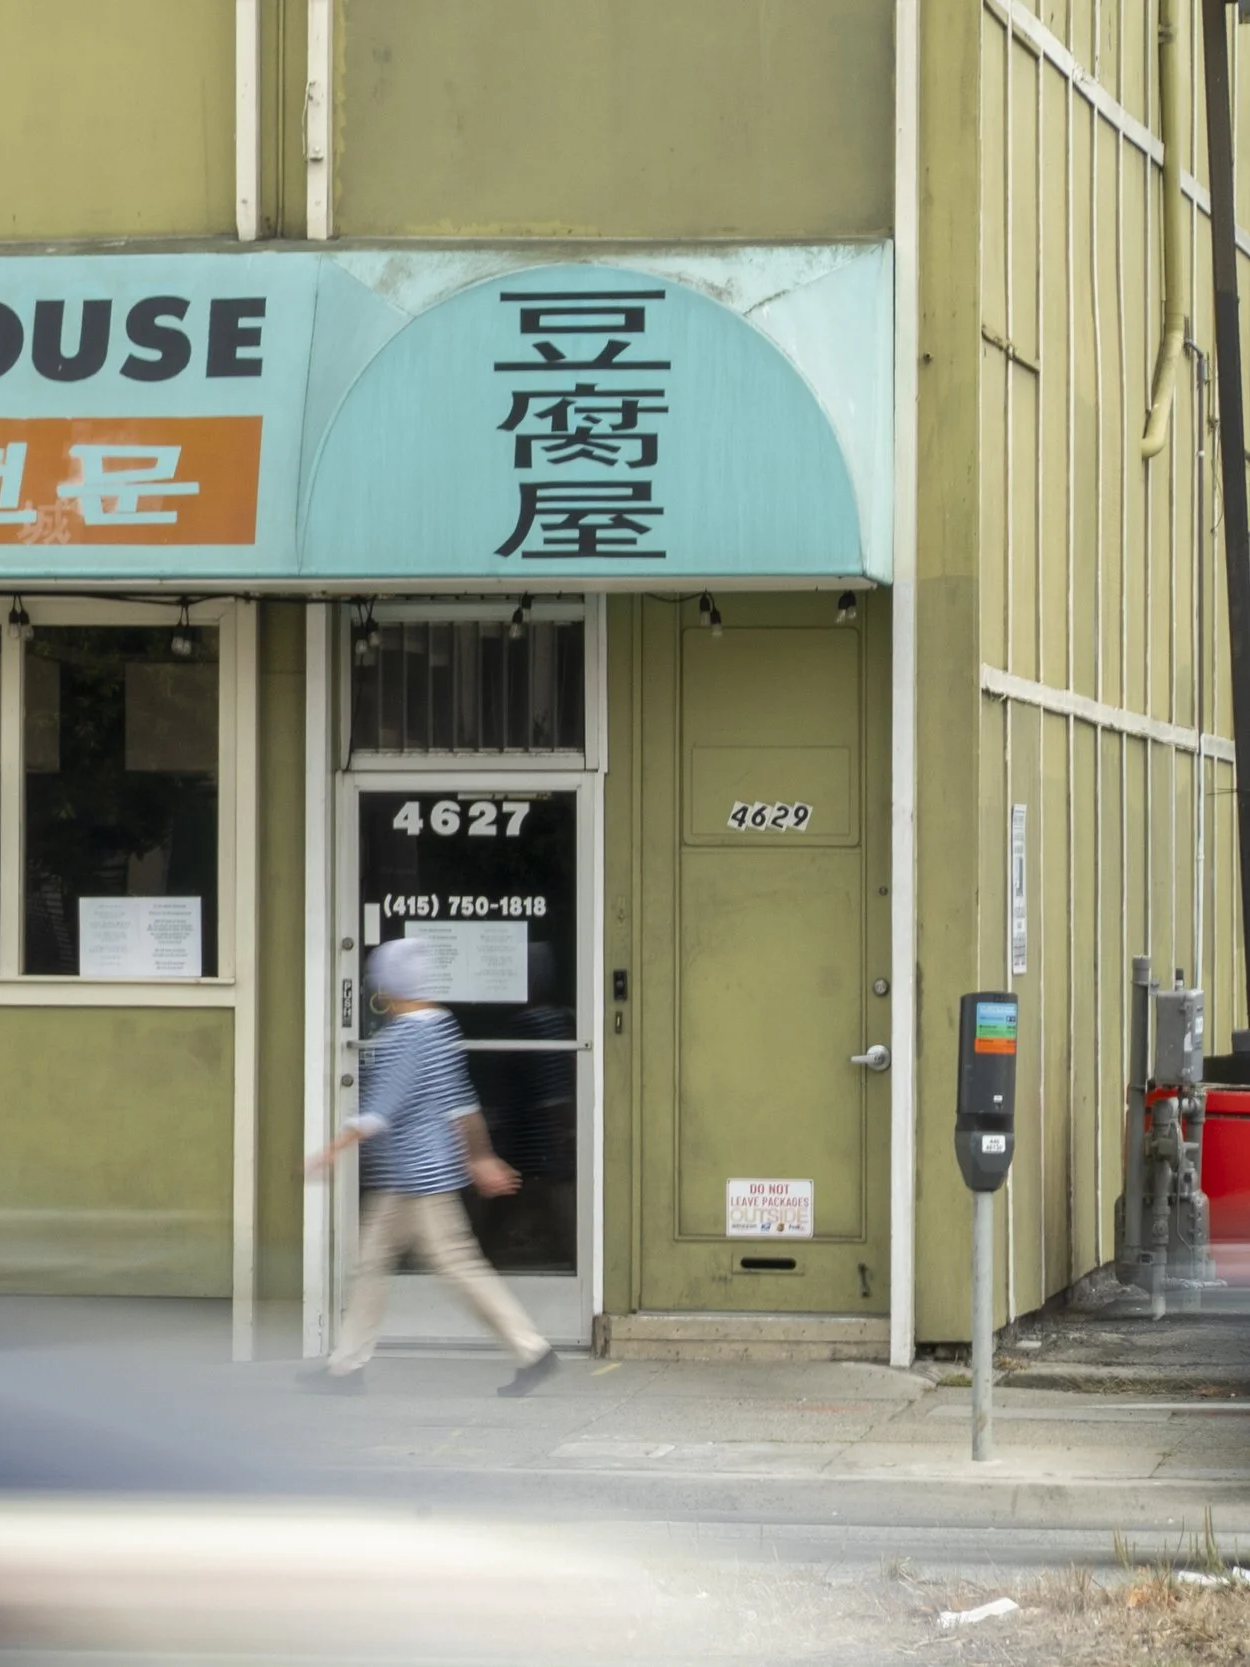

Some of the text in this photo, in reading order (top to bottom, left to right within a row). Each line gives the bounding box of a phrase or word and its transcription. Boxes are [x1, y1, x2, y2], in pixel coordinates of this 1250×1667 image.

[493, 289, 671, 558] 豆腐屋
[392, 800, 531, 837] 4627
[730, 804, 809, 829] 4629
[383, 893, 547, 918] (415) 750-1818
[749, 1183, 790, 1195] DO NOT
[730, 1196, 810, 1208] LEAVE PACKAGES
[730, 1207, 810, 1224] OUTSIDE
